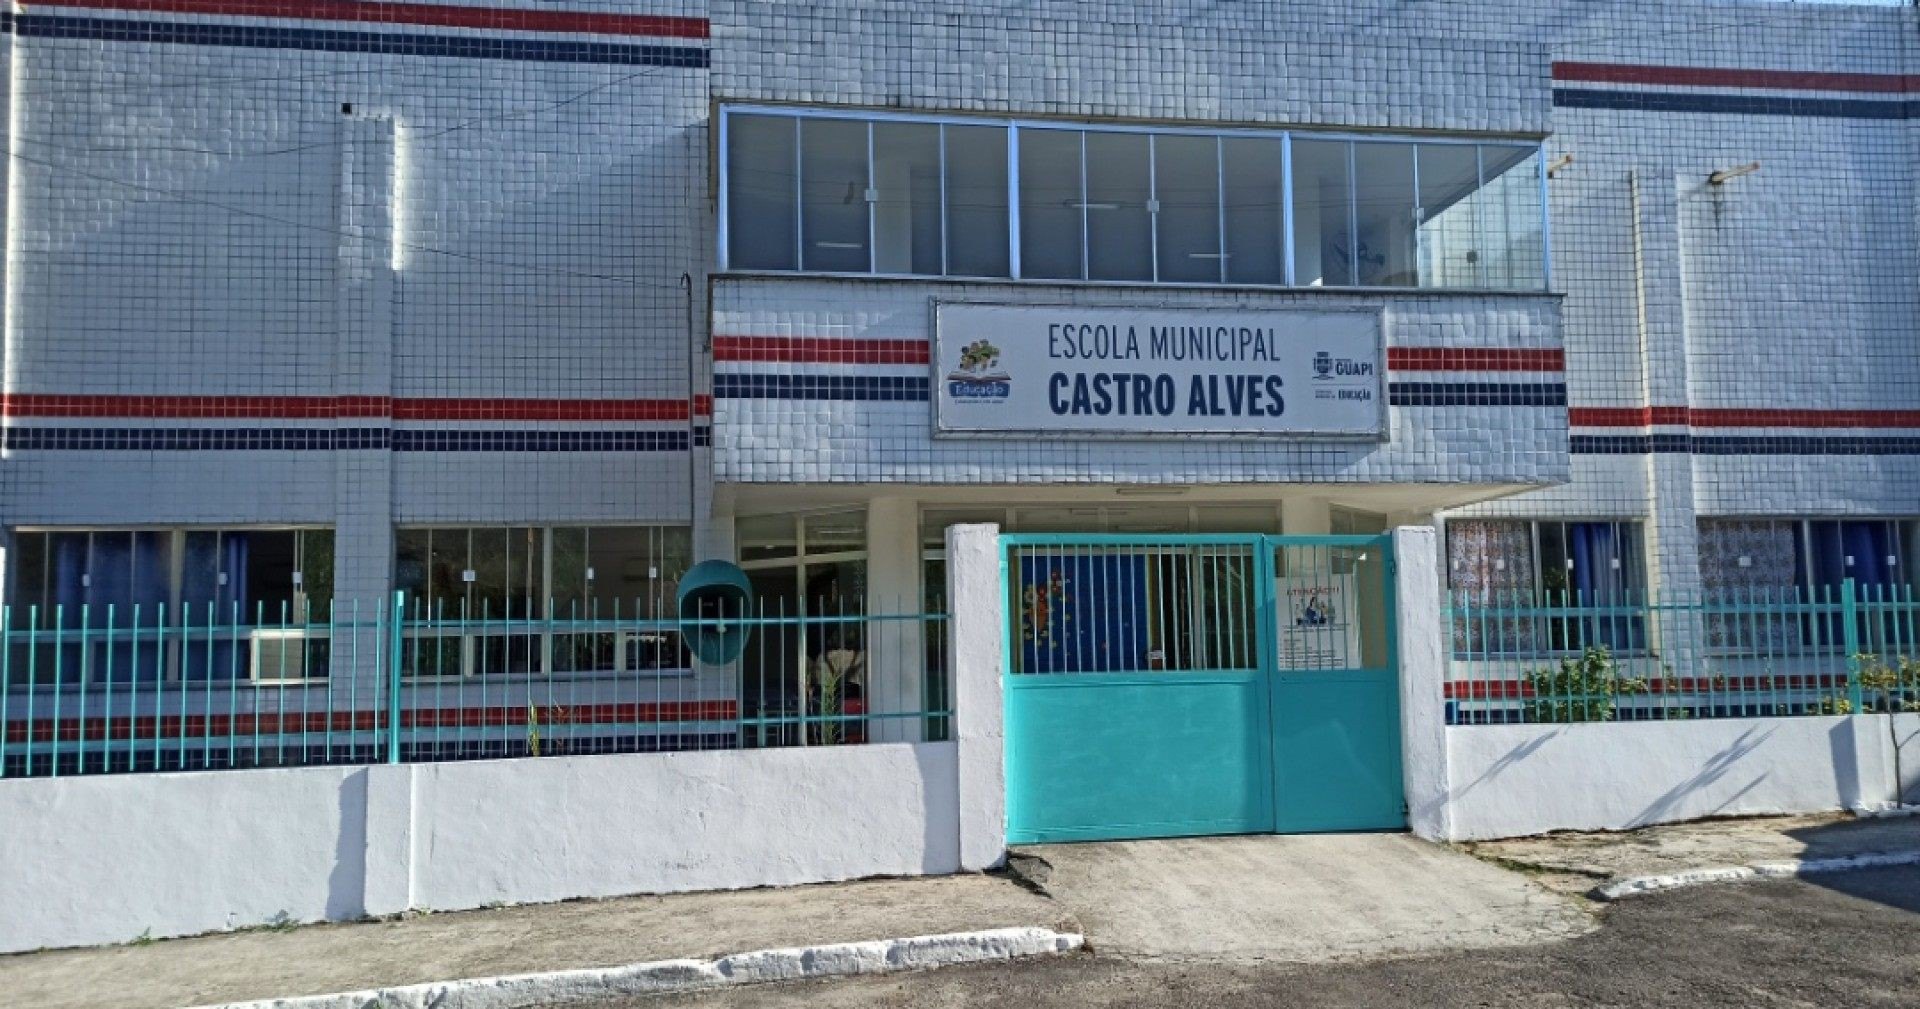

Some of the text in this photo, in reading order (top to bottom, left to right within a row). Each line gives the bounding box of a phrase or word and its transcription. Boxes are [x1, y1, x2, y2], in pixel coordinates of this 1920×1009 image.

[1049, 323, 1281, 361] ESCOLA MUNICIPAL
[1336, 361, 1373, 376] GUAPI
[1049, 371, 1285, 417] CASTRO ALVES
